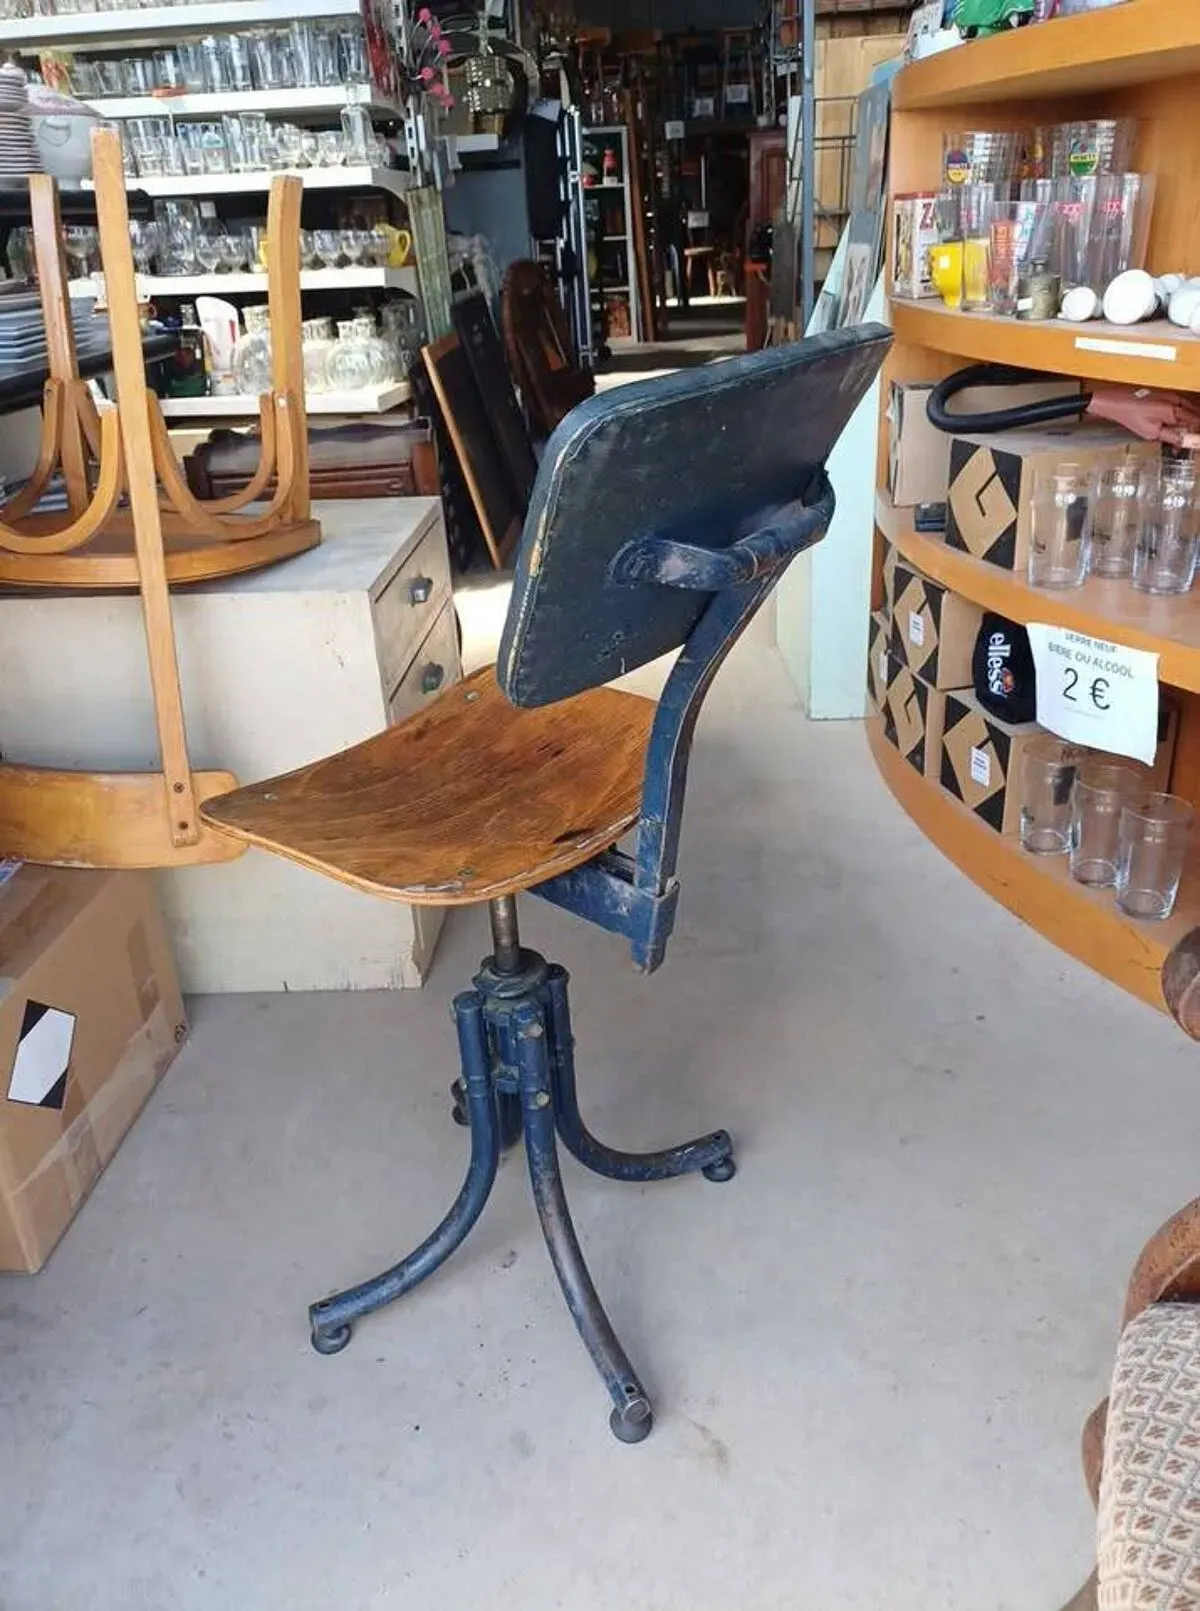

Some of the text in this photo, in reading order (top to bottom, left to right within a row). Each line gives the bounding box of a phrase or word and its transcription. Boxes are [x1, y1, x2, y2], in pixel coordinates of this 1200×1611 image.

[987, 632, 1011, 698] elless
[1075, 651, 1091, 664] OU
[1093, 657, 1134, 679] ALCOOL
[1062, 667, 1110, 711] 2 €
